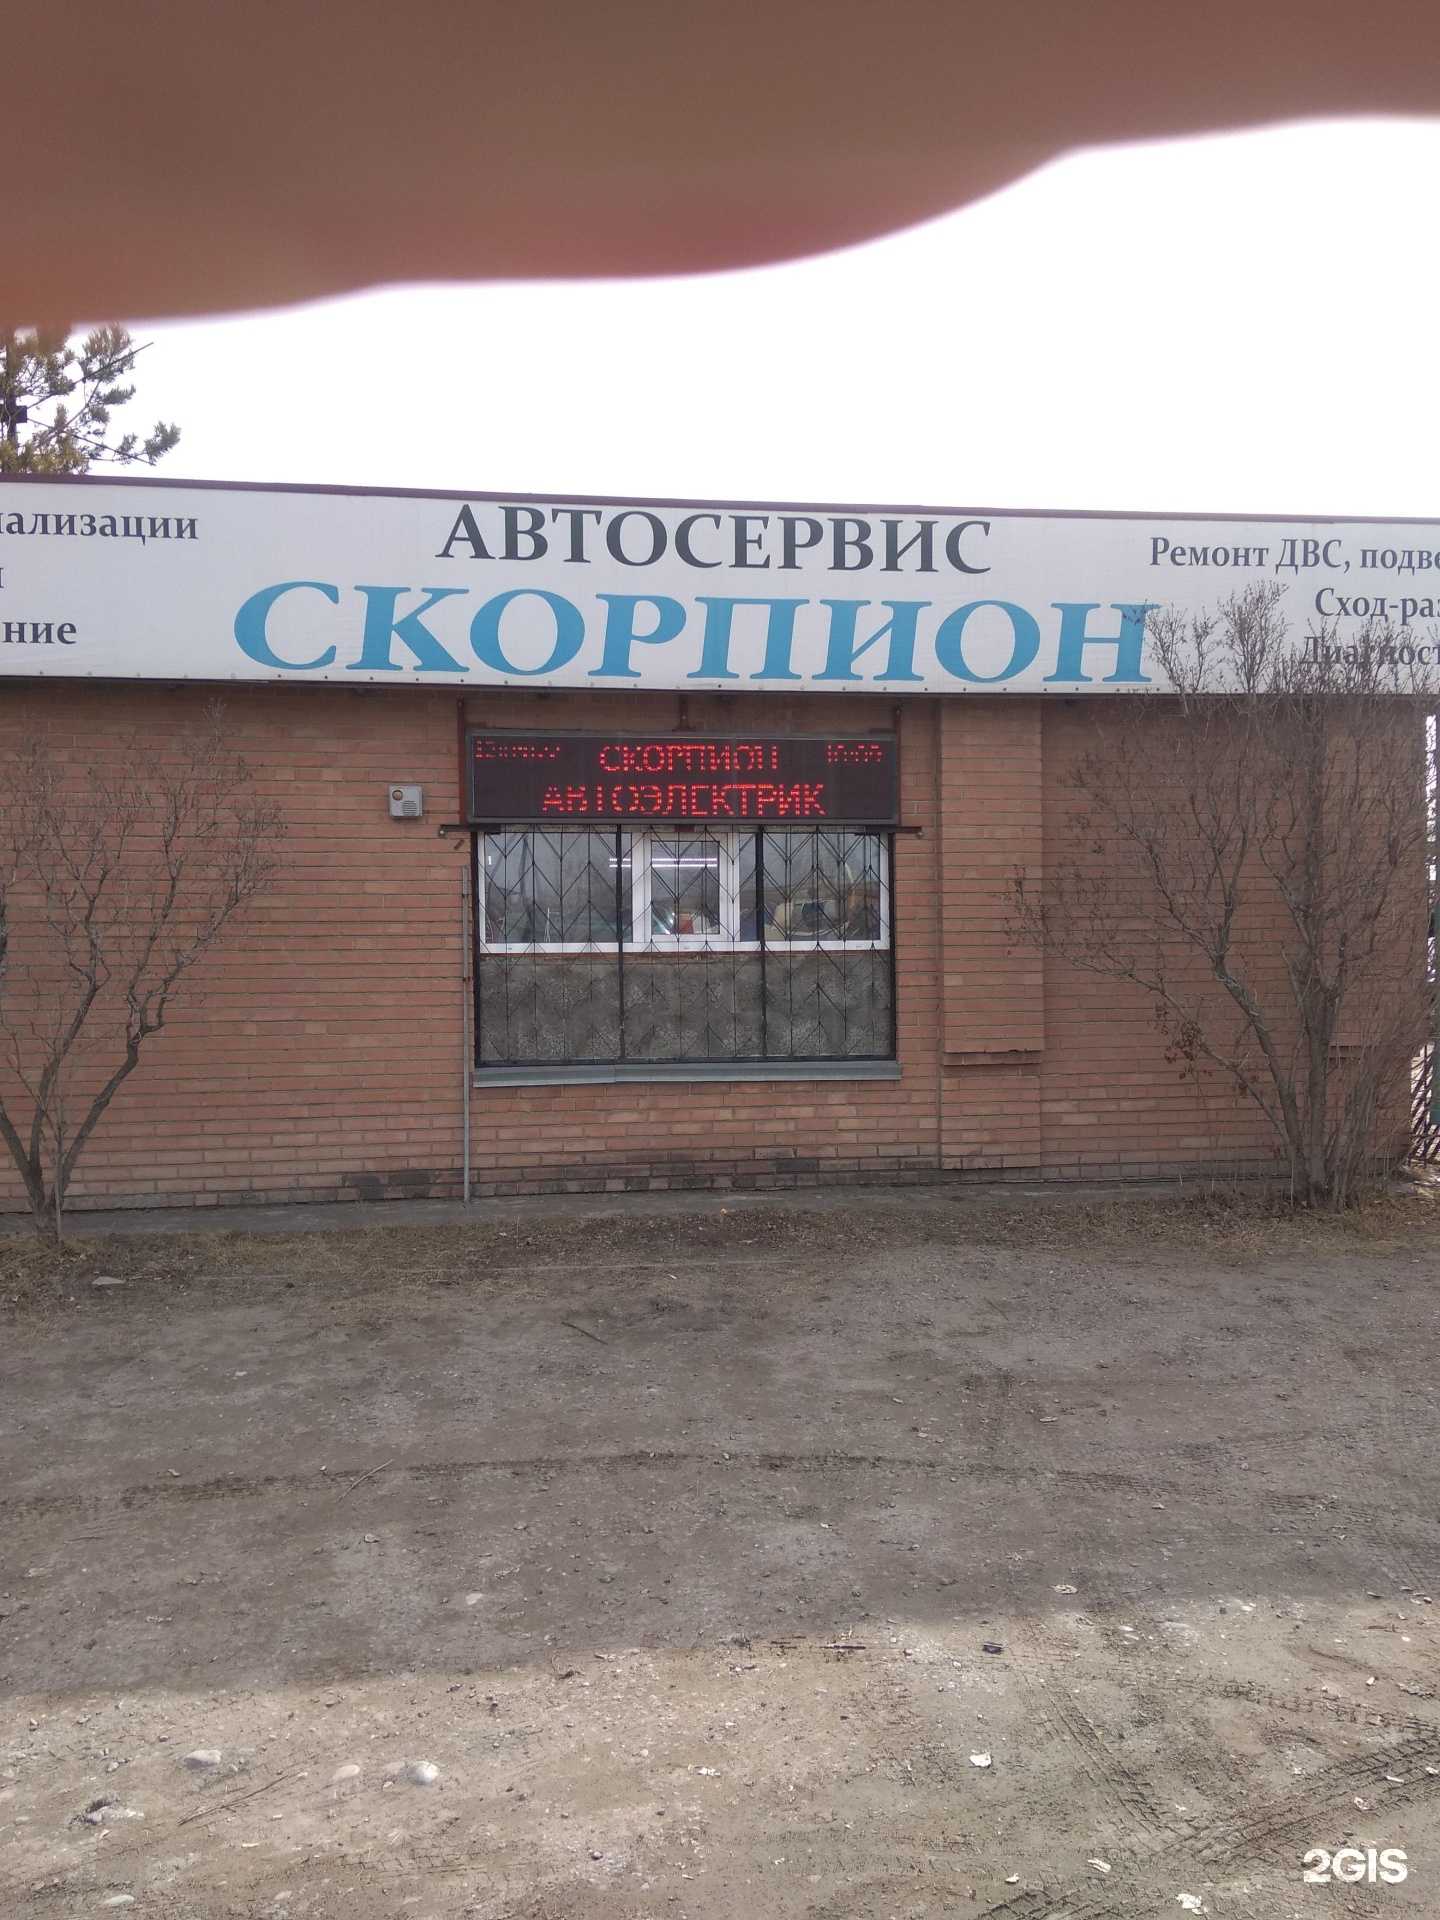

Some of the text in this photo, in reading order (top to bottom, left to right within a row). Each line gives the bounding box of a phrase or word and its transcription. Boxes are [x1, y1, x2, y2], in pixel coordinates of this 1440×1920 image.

[0, 512, 198, 545] ализации
[435, 502, 992, 574] АВТОСЕРВИС
[1150, 537, 1269, 567] Ремонт
[1275, 538, 1351, 575] ДВС,
[1315, 587, 1440, 626] Сход-ра
[233, 580, 1160, 683] СКОРПИОН
